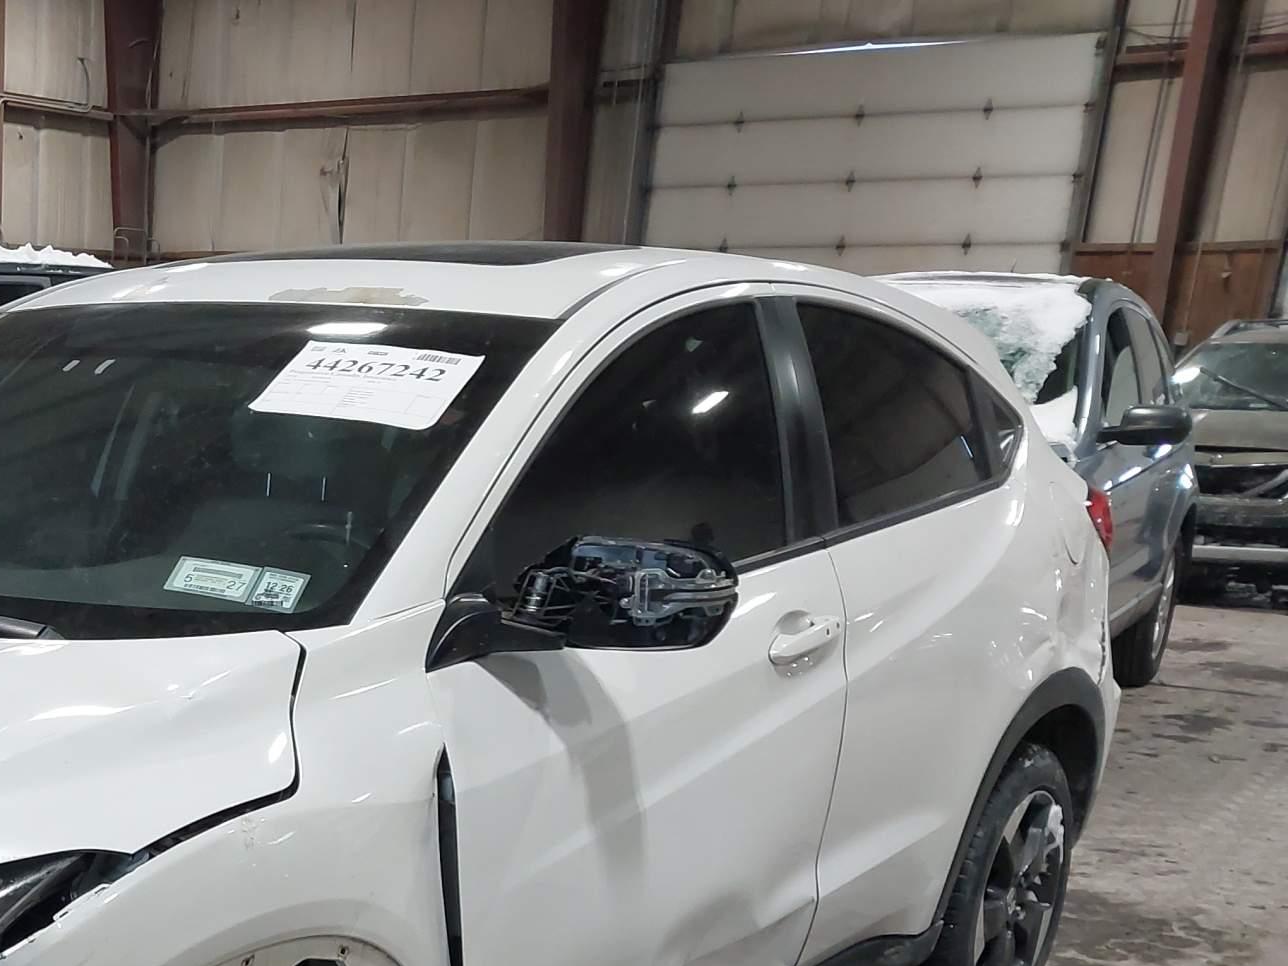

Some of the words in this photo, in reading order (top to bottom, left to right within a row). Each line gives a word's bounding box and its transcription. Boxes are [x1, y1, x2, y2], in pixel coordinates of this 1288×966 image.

[305, 357, 447, 382] 44267242
[183, 573, 194, 583] 5
[226, 580, 248, 591] 27
